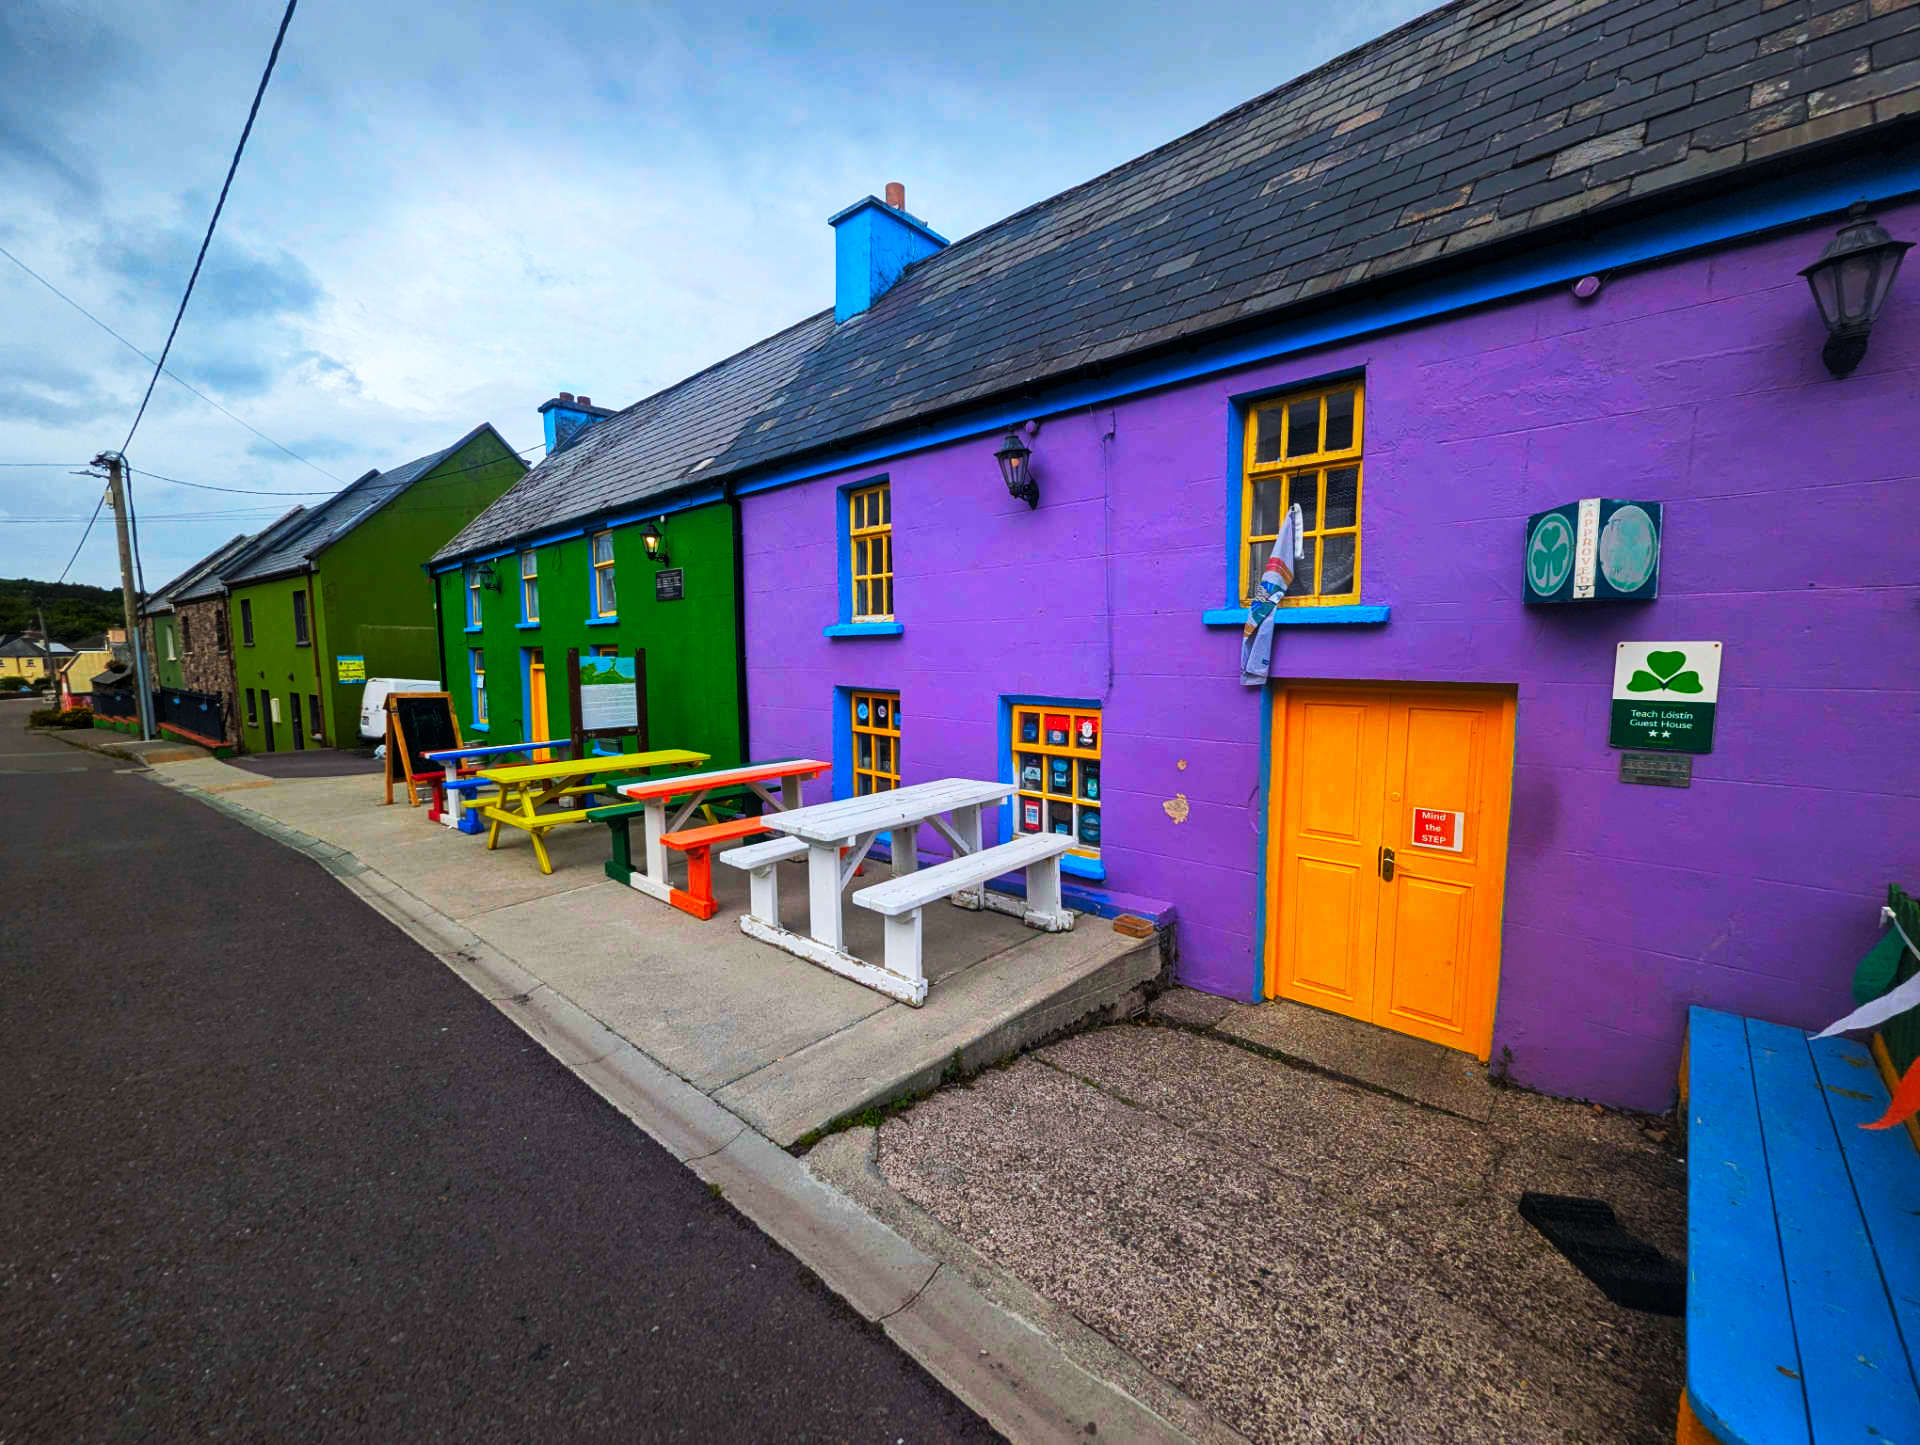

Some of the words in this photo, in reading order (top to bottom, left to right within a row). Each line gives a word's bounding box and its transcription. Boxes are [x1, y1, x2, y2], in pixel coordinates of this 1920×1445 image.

[1580, 511, 1593, 584] APPROVED
[1631, 709, 1658, 718] Teach
[1629, 718, 1658, 727] Guest
[1661, 720, 1693, 729] House
[1422, 811, 1446, 821] Mind
[1425, 824, 1441, 832] the
[1422, 834, 1446, 844] STEP
